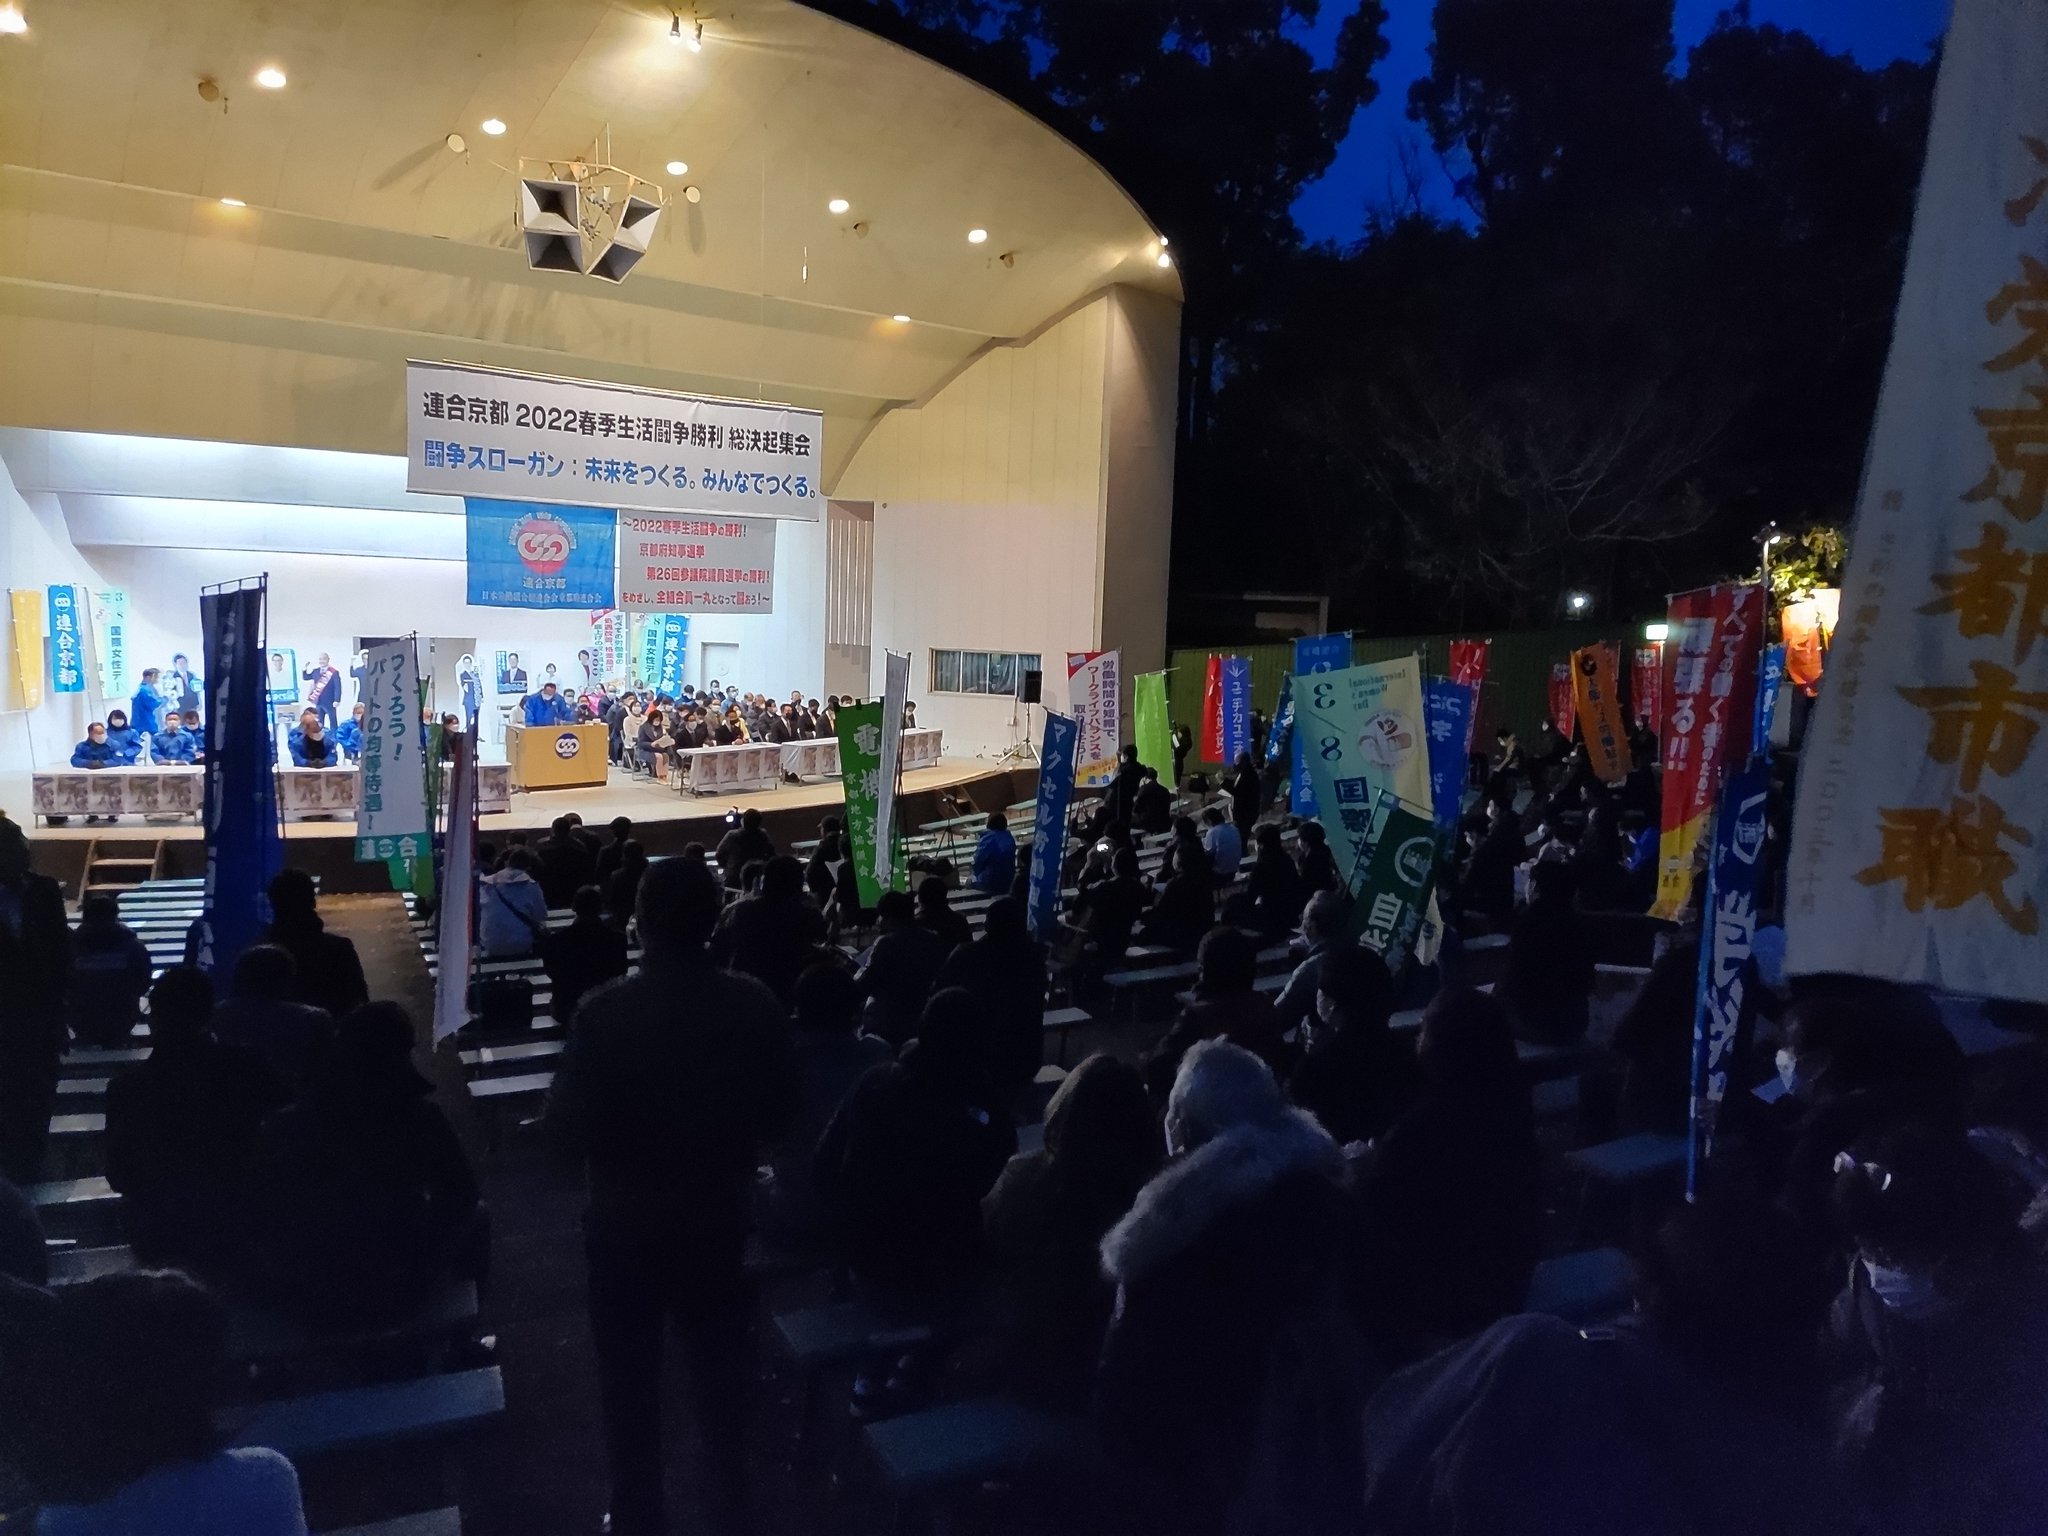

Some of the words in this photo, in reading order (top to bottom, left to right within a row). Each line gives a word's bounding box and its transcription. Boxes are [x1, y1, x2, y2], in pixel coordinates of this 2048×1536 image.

[423, 391, 510, 426] 連合京都
[516, 403, 723, 449] 2022春季生活闘争勝利
[728, 426, 810, 457] 総決起集会
[522, 576, 567, 589] 連合京都
[639, 542, 705, 558] 京都府知事選挙
[56, 613, 78, 686] 連合京都
[661, 637, 679, 693] 連合京都
[387, 653, 406, 760] つくろう！
[1102, 660, 1116, 742] 労働時間の短縮で、
